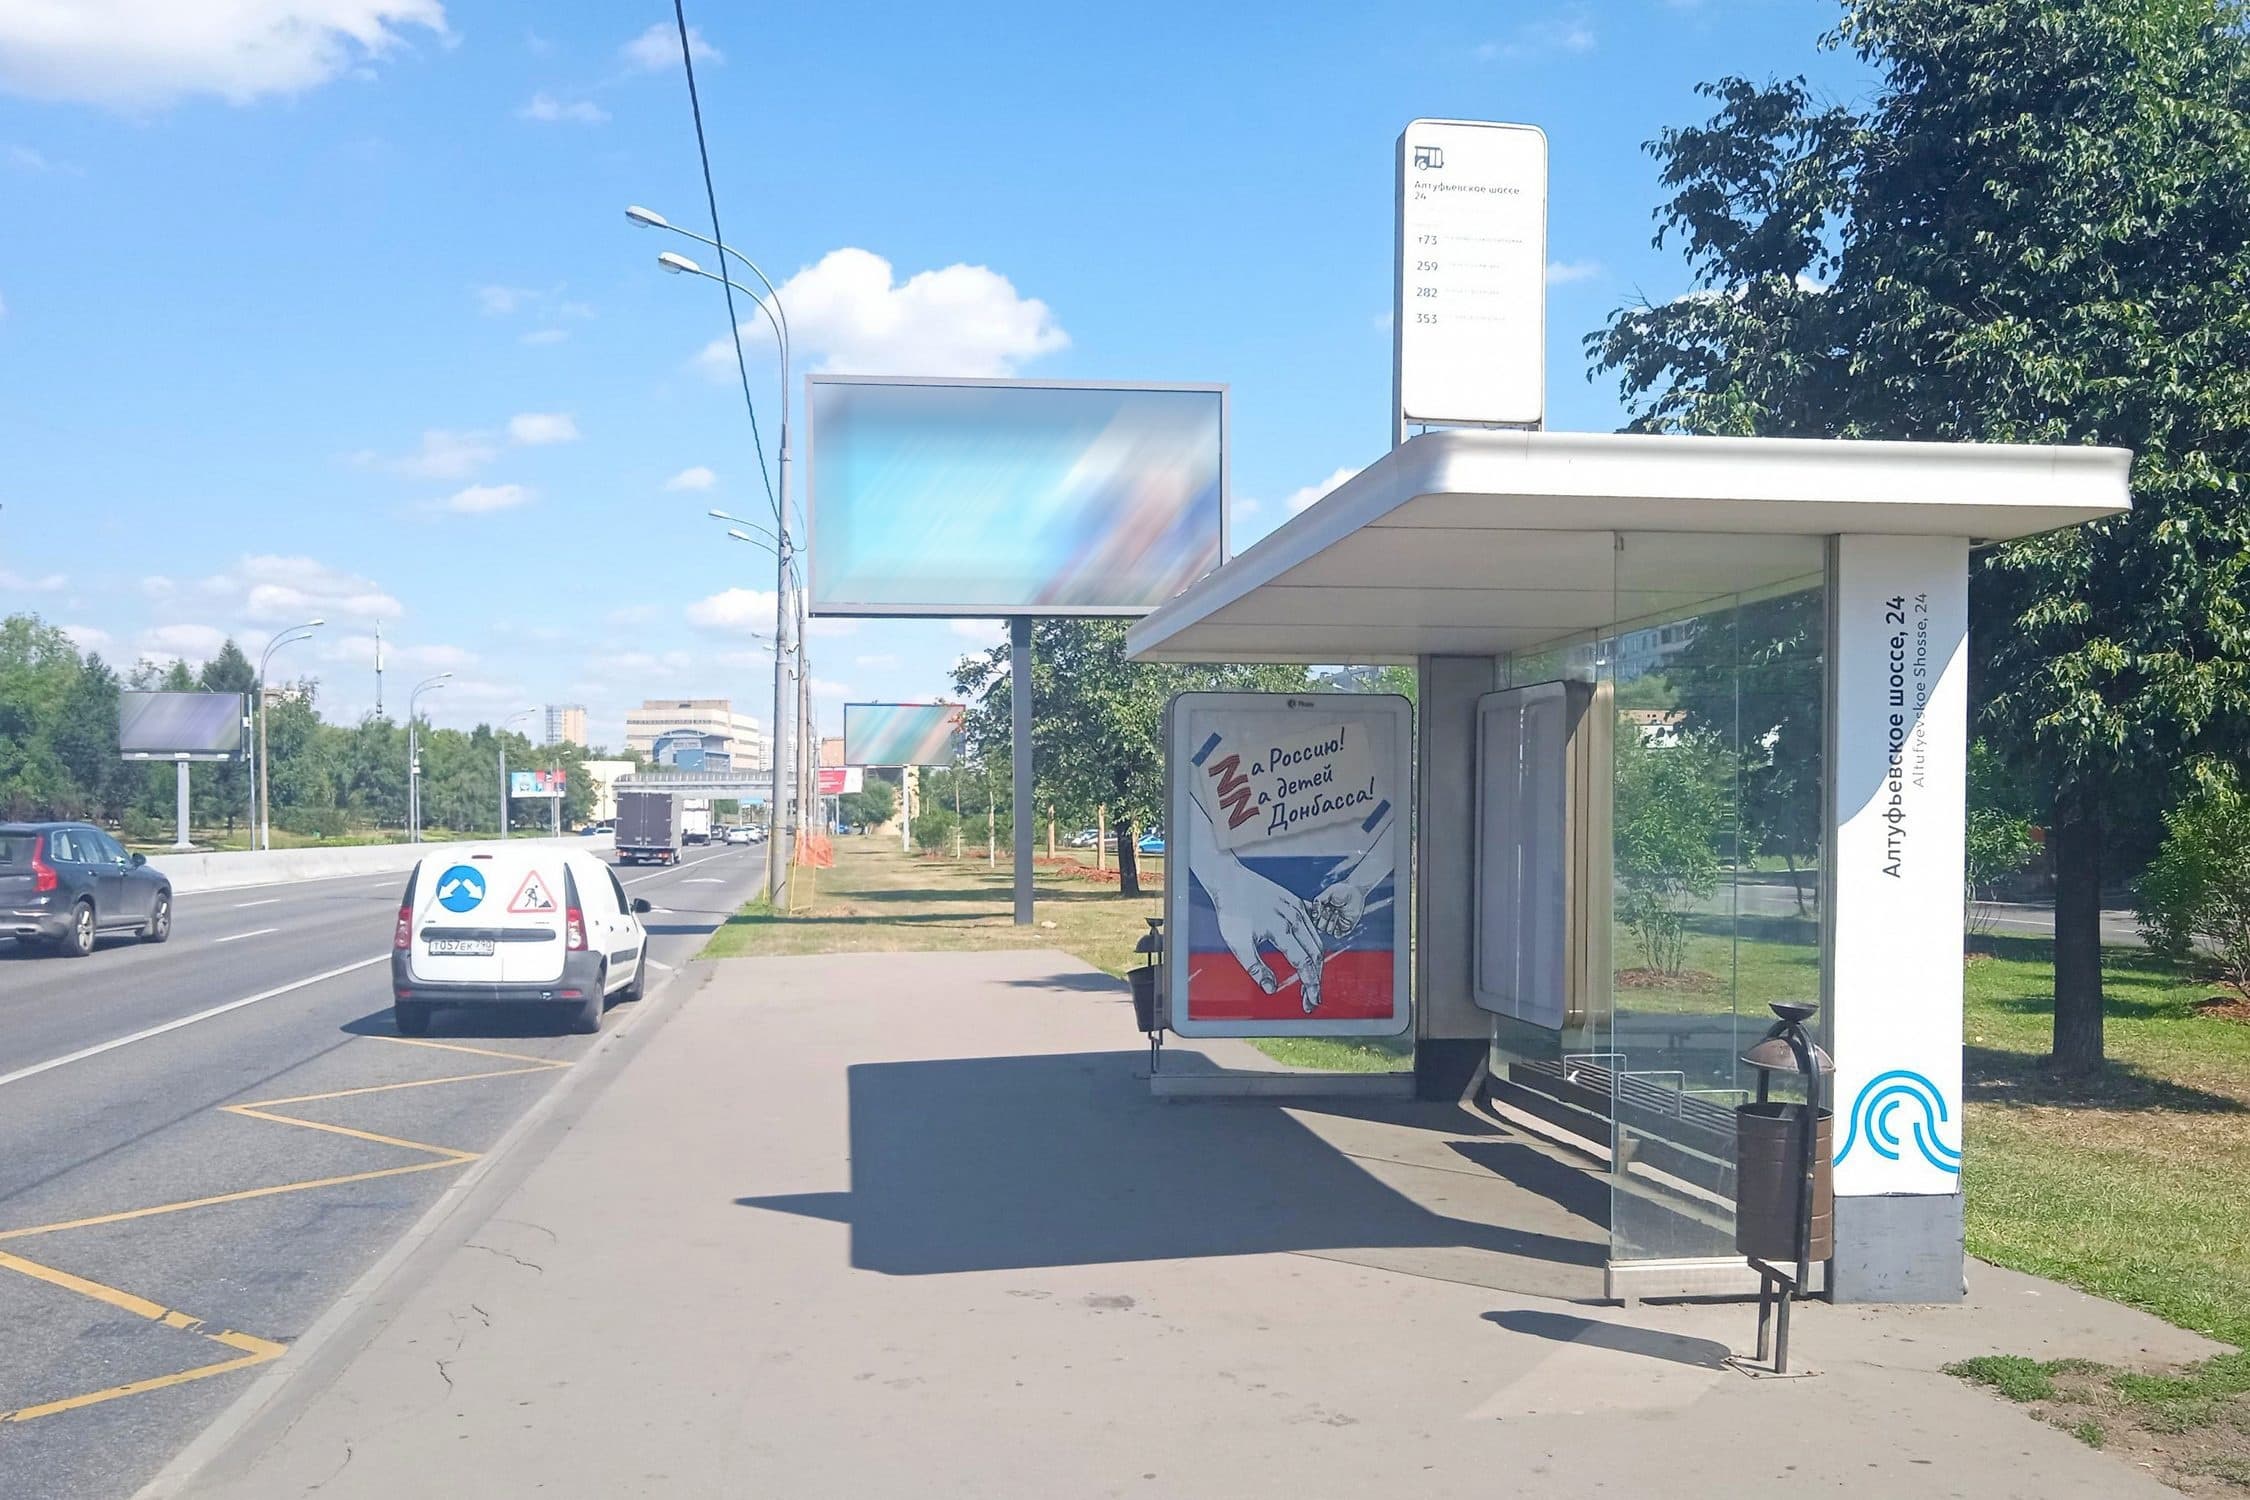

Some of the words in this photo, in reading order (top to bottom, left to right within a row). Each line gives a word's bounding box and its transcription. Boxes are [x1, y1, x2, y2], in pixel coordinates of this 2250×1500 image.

[1414, 191, 1427, 200] 24
[1488, 187, 1520, 195] шоссе
[1416, 260, 1439, 272] 259
[1416, 286, 1438, 298] 282
[1416, 313, 1438, 325] 353
[1886, 595, 1905, 625] 24
[1914, 592, 1928, 613] 24
[1913, 618, 1929, 677] Shosse,
[1889, 631, 1909, 707] шоссе,
[1269, 726, 1345, 773] Россию!
[1911, 682, 1927, 788] Altufyevskoe
[1277, 763, 1333, 800] детей
[1882, 713, 1906, 879] Алтуфьевское
[1267, 775, 1375, 836] Донбасса!
